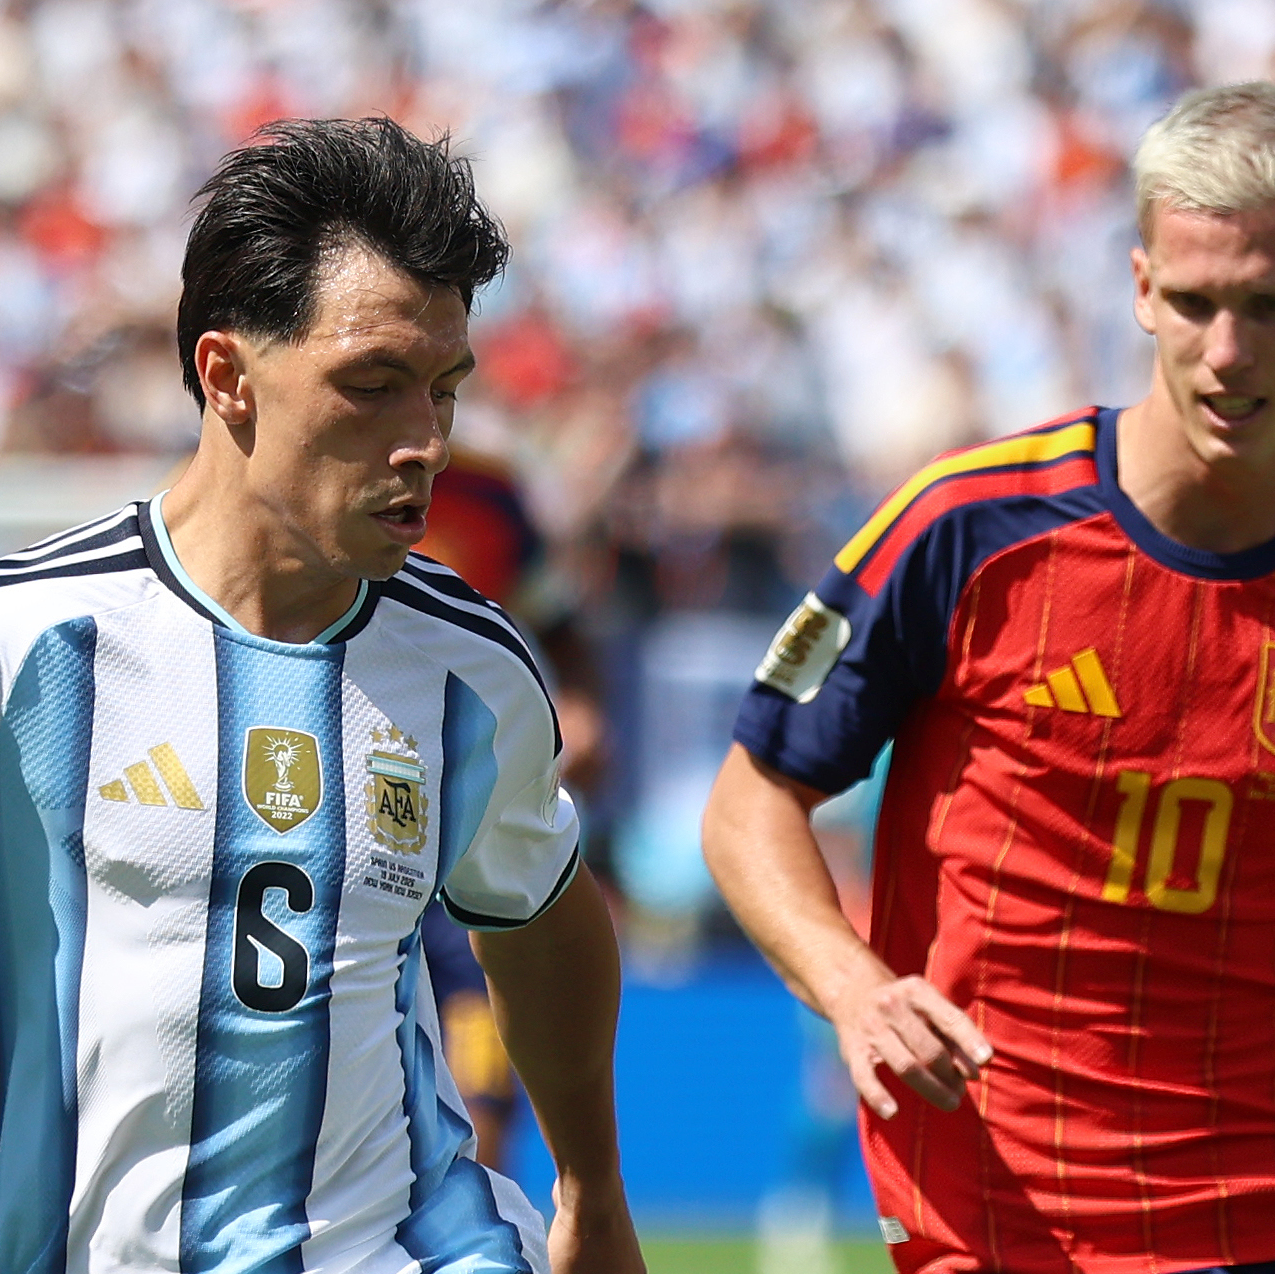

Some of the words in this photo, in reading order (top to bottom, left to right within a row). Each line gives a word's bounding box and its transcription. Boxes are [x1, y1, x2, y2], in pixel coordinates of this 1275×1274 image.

[266, 791, 301, 807] FIFA
[271, 811, 293, 820] 2022
[379, 777, 417, 827] AFA
[1101, 770, 1234, 914] 10
[231, 860, 315, 1013] 6
